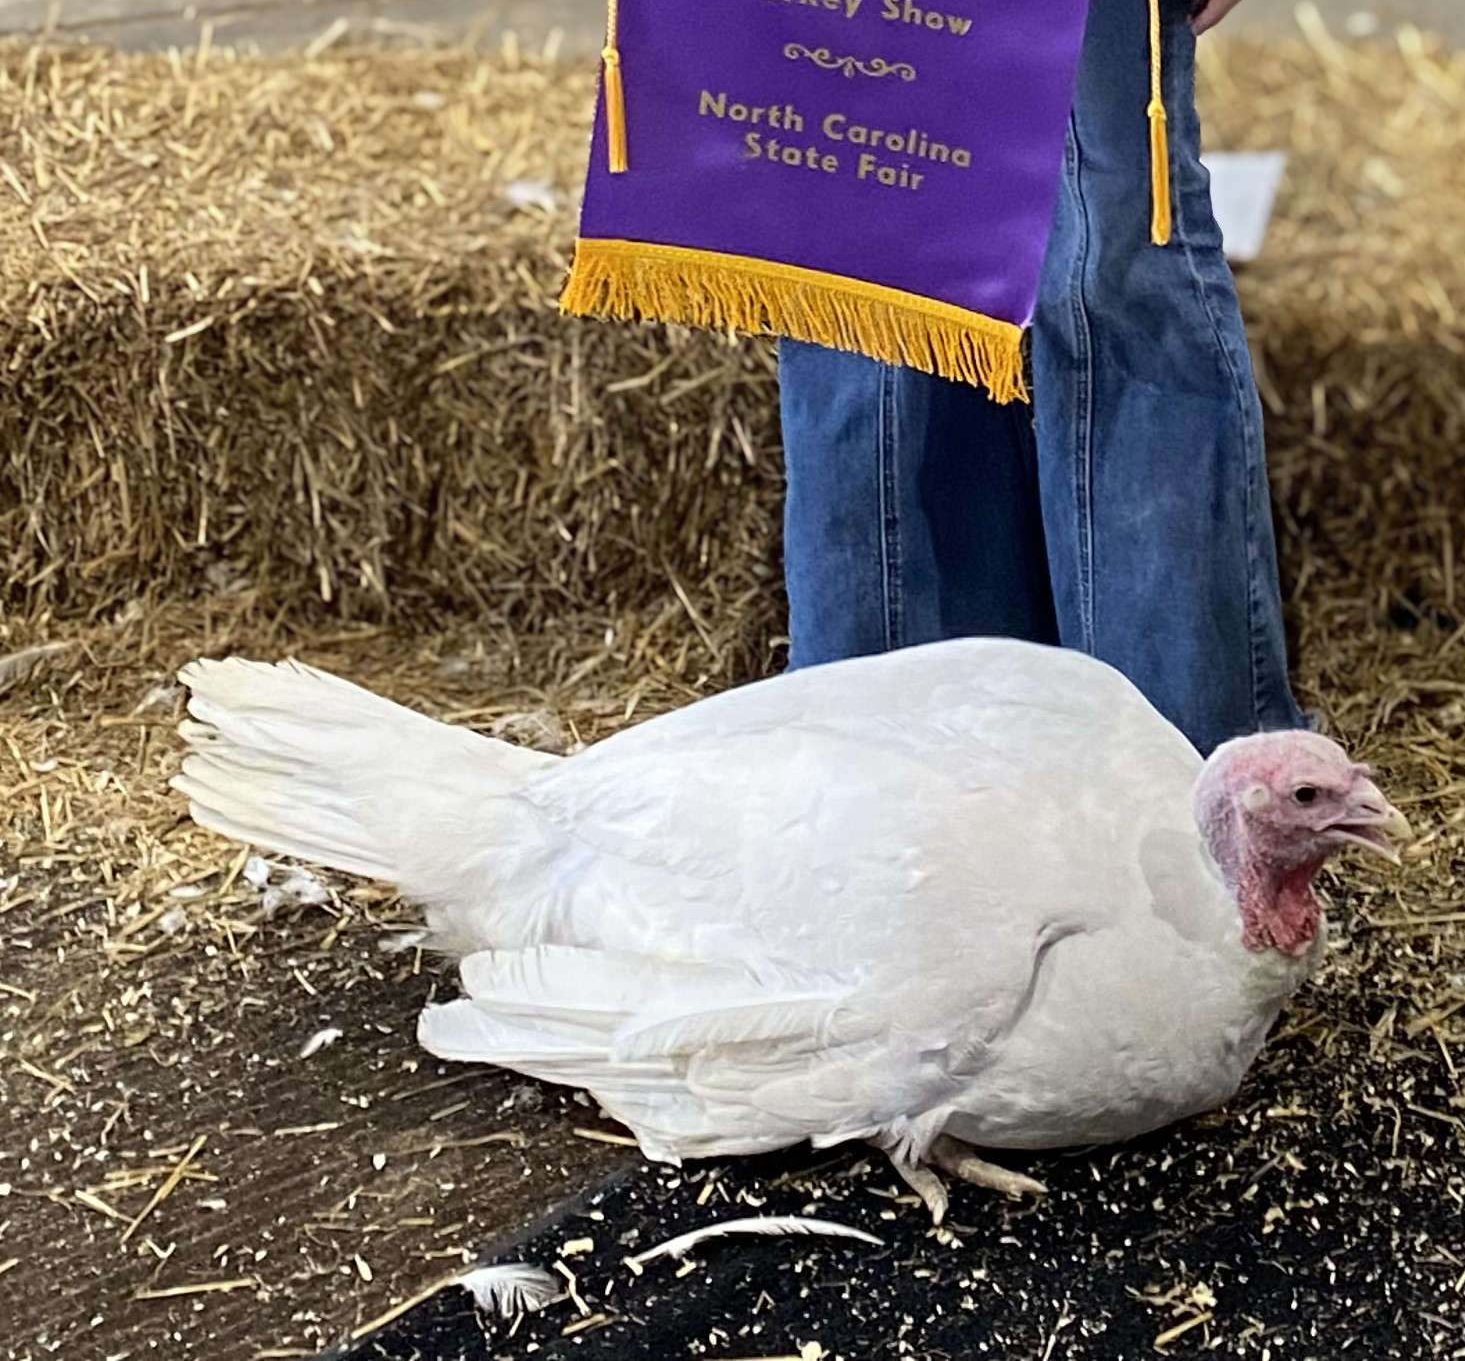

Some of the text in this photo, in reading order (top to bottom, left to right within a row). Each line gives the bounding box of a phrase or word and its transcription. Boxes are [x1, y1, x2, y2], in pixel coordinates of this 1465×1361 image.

[698, 90, 972, 168] North Carolina
[743, 133, 924, 190] State Fair
